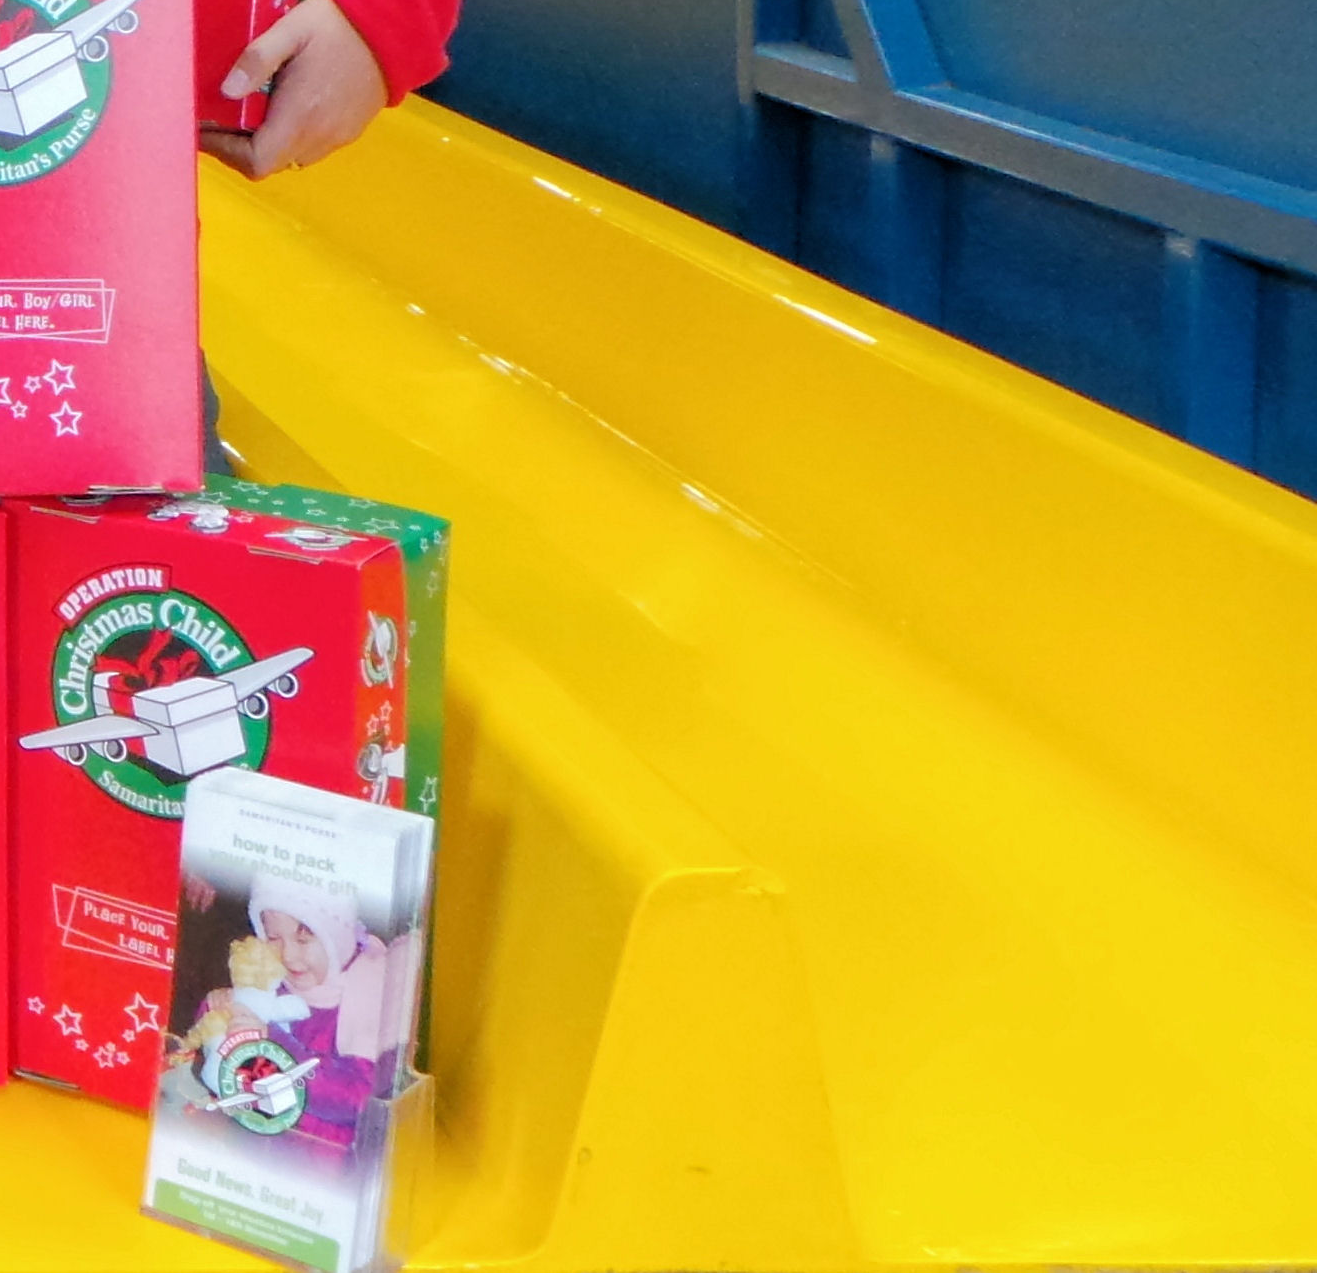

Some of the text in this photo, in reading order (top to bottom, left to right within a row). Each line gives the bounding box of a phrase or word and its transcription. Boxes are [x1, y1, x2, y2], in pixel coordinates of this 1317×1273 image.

[47, 106, 96, 160] Purse
[59, 568, 164, 620] OPERATION
[60, 599, 239, 716] Christmas Child
[99, 770, 185, 815] Samarita
[233, 833, 337, 873] how to pack
[251, 859, 324, 888] shoebox
[328, 879, 358, 895] gift
